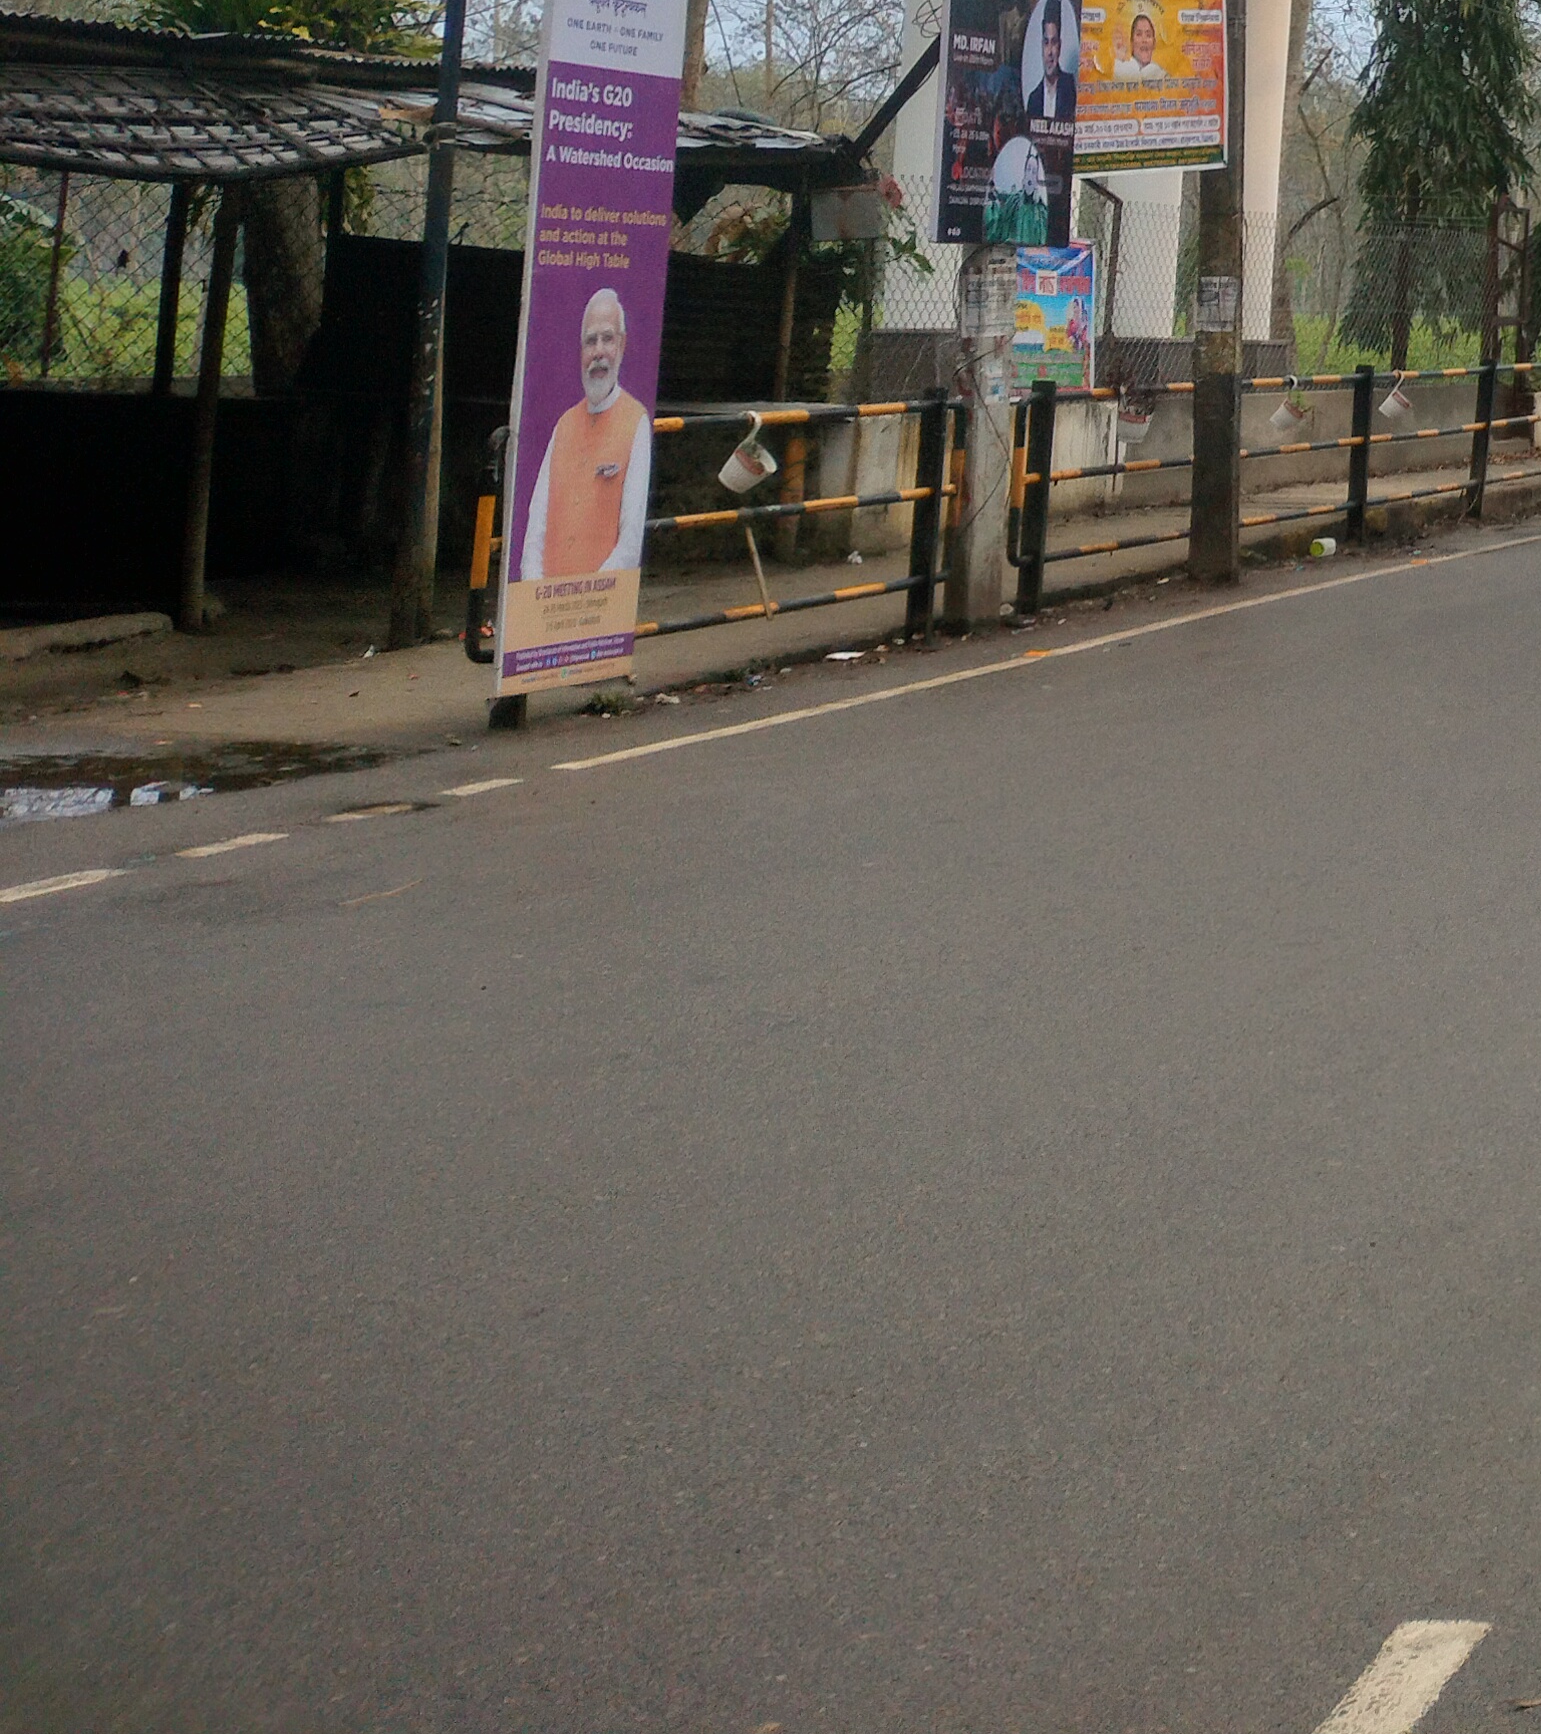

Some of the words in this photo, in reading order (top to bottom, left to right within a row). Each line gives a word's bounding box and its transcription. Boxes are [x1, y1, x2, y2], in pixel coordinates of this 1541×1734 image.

[566, 17, 585, 31] ONE
[585, 21, 613, 35] EARTH
[619, 27, 637, 40] ONE
[637, 29, 665, 43] FAMILY
[589, 39, 607, 52] ONE
[608, 42, 639, 57] FUTURE
[953, 33, 970, 51] MD.
[970, 36, 996, 55] IRFAN
[551, 77, 601, 105] India's
[603, 84, 633, 108] G20
[548, 109, 634, 143] Presidency:
[1030, 118, 1049, 134] NEEL
[546, 145, 557, 163] A
[559, 146, 623, 169] Watershed
[624, 152, 675, 174] Occasion
[541, 203, 569, 221] India
[571, 207, 583, 222] to
[585, 206, 621, 225] deliver
[622, 209, 667, 228] solutions
[539, 229, 561, 243] and
[562, 230, 597, 245] action
[597, 233, 609, 246] at
[610, 231, 629, 247] the
[538, 249, 574, 266] Global
[575, 251, 601, 271] High
[602, 253, 631, 269] Table
[553, 579, 584, 599] MEETING
[593, 576, 617, 592] ASSAM
